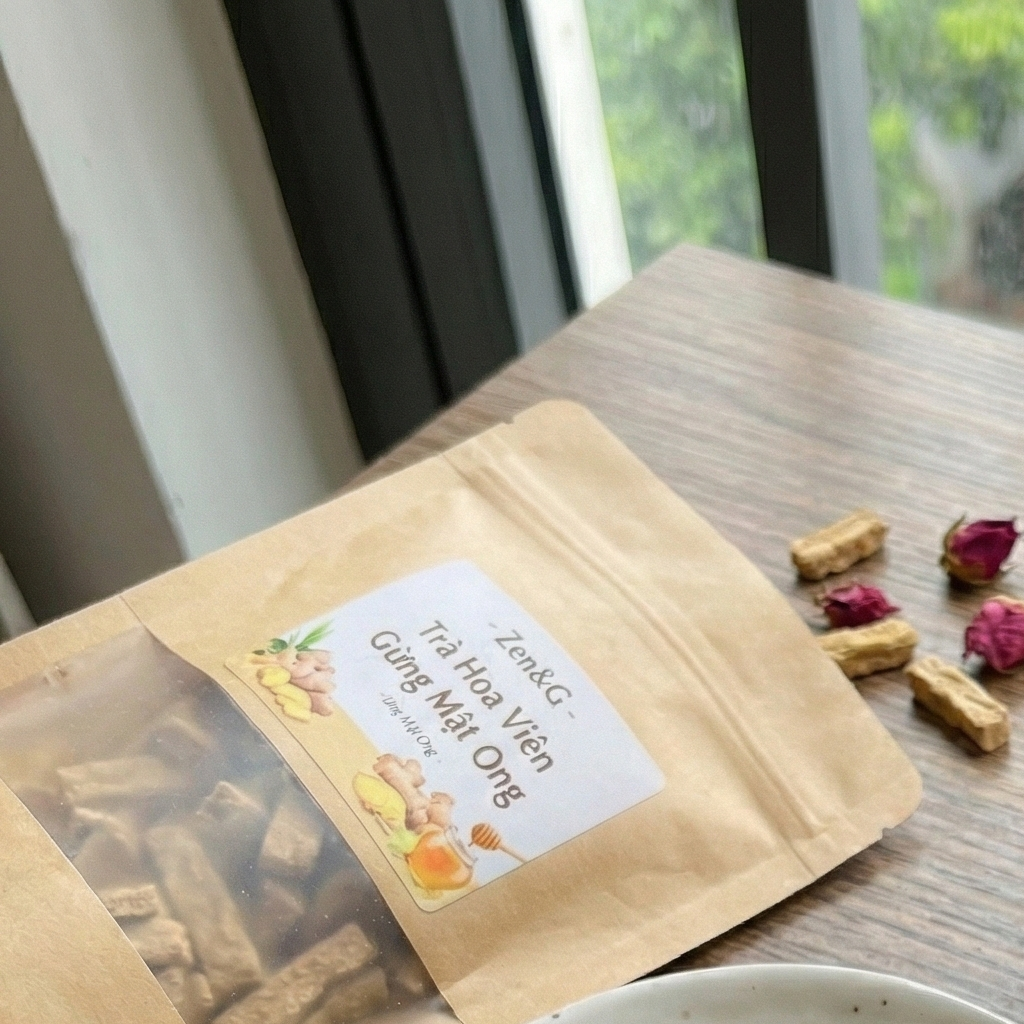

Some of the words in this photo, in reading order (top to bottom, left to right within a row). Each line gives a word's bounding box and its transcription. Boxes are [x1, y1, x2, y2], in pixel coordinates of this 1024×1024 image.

[419, 620, 463, 660] Trà
[453, 656, 504, 710] Hoa
[501, 705, 554, 773] Viên
[493, 629, 572, 708] Zen&G
[425, 689, 479, 742] Mật
[473, 745, 526, 809] Ong
